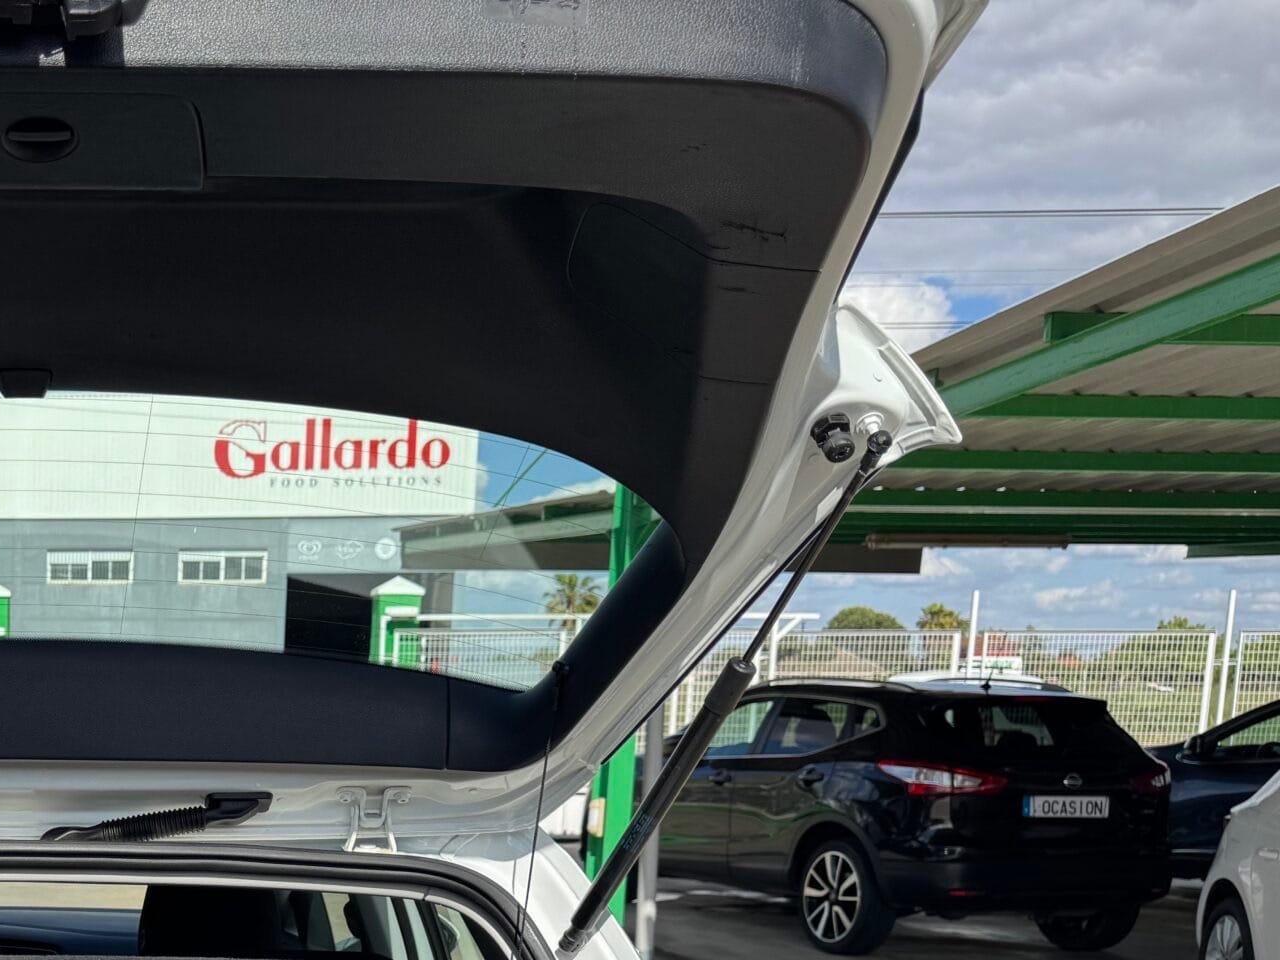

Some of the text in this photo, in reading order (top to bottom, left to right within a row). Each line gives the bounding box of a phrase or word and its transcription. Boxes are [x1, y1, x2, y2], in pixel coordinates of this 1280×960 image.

[214, 418, 451, 479] Gallardo
[270, 475, 443, 489] FOOD SOLUTIONS
[1041, 799, 1103, 816] OCASION
